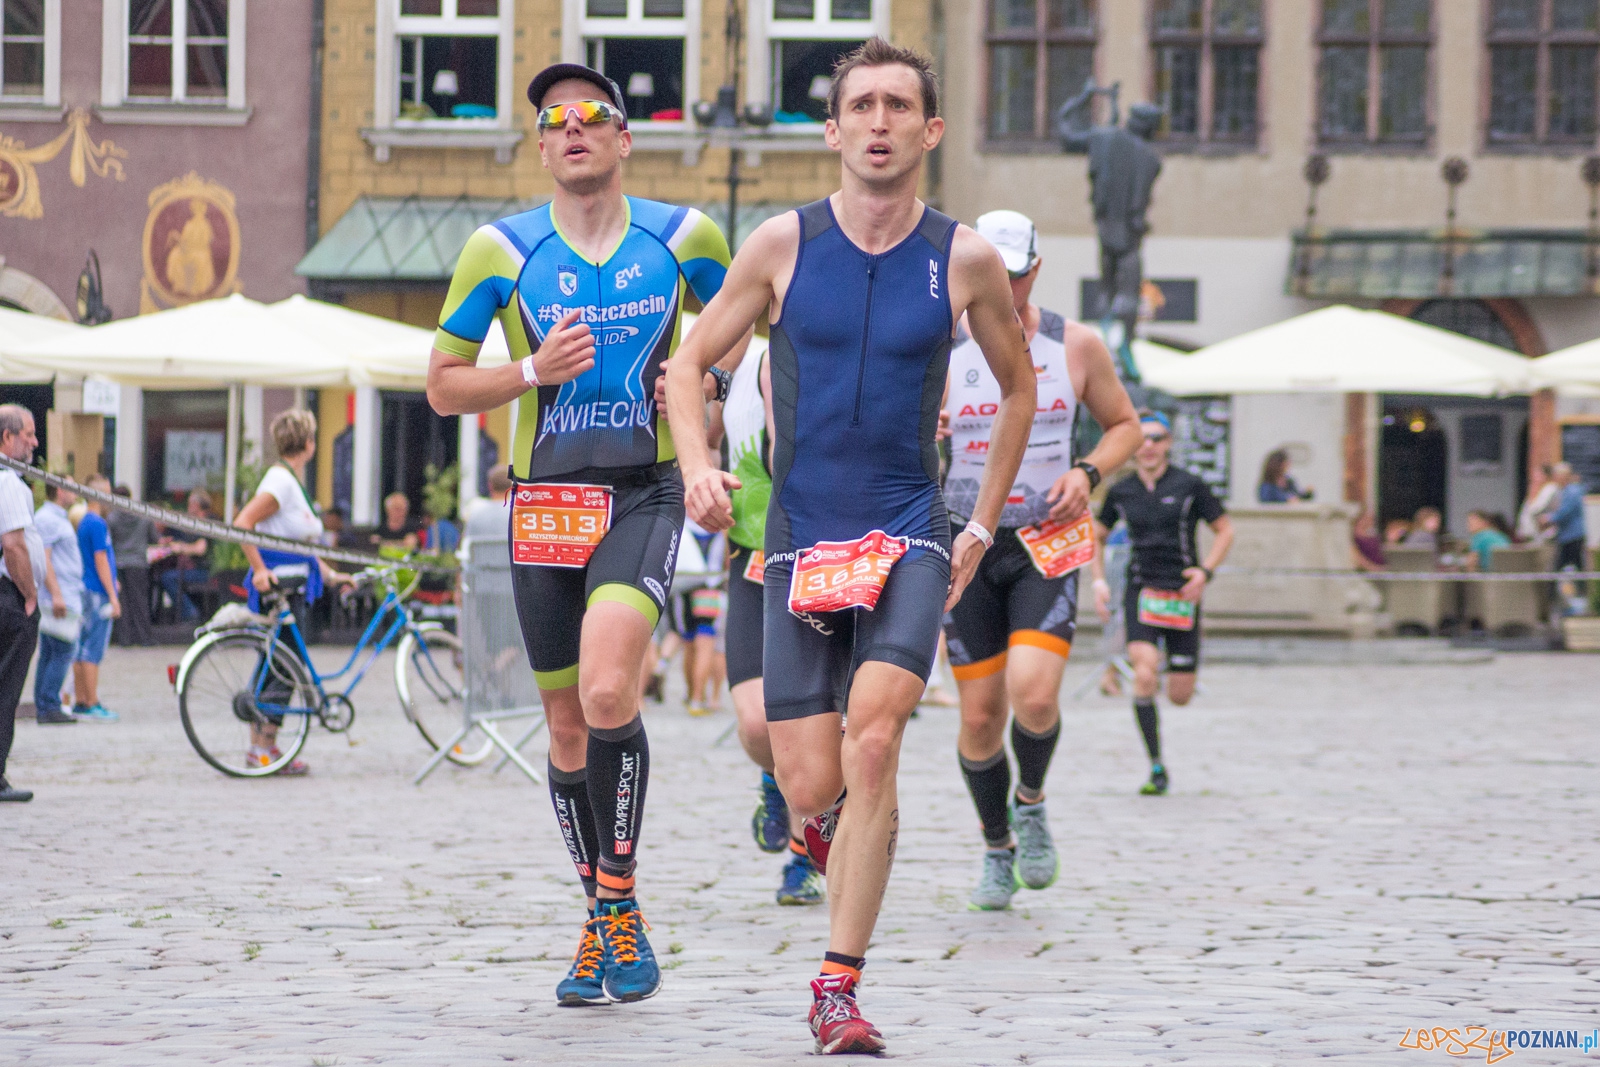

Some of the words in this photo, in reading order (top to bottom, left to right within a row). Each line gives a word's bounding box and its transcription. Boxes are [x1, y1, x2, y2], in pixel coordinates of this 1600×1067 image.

[615, 263, 643, 290] gvt
[929, 258, 939, 299] 2XU
[594, 330, 628, 346] LIDE
[541, 398, 654, 434] KWIECIU
[521, 512, 596, 533] 3513
[528, 532, 558, 540] KRZYSZTOF
[663, 529, 678, 577] FINIS
[764, 552, 796, 568] wline
[908, 538, 951, 561] newline
[807, 556, 894, 592] 3655
